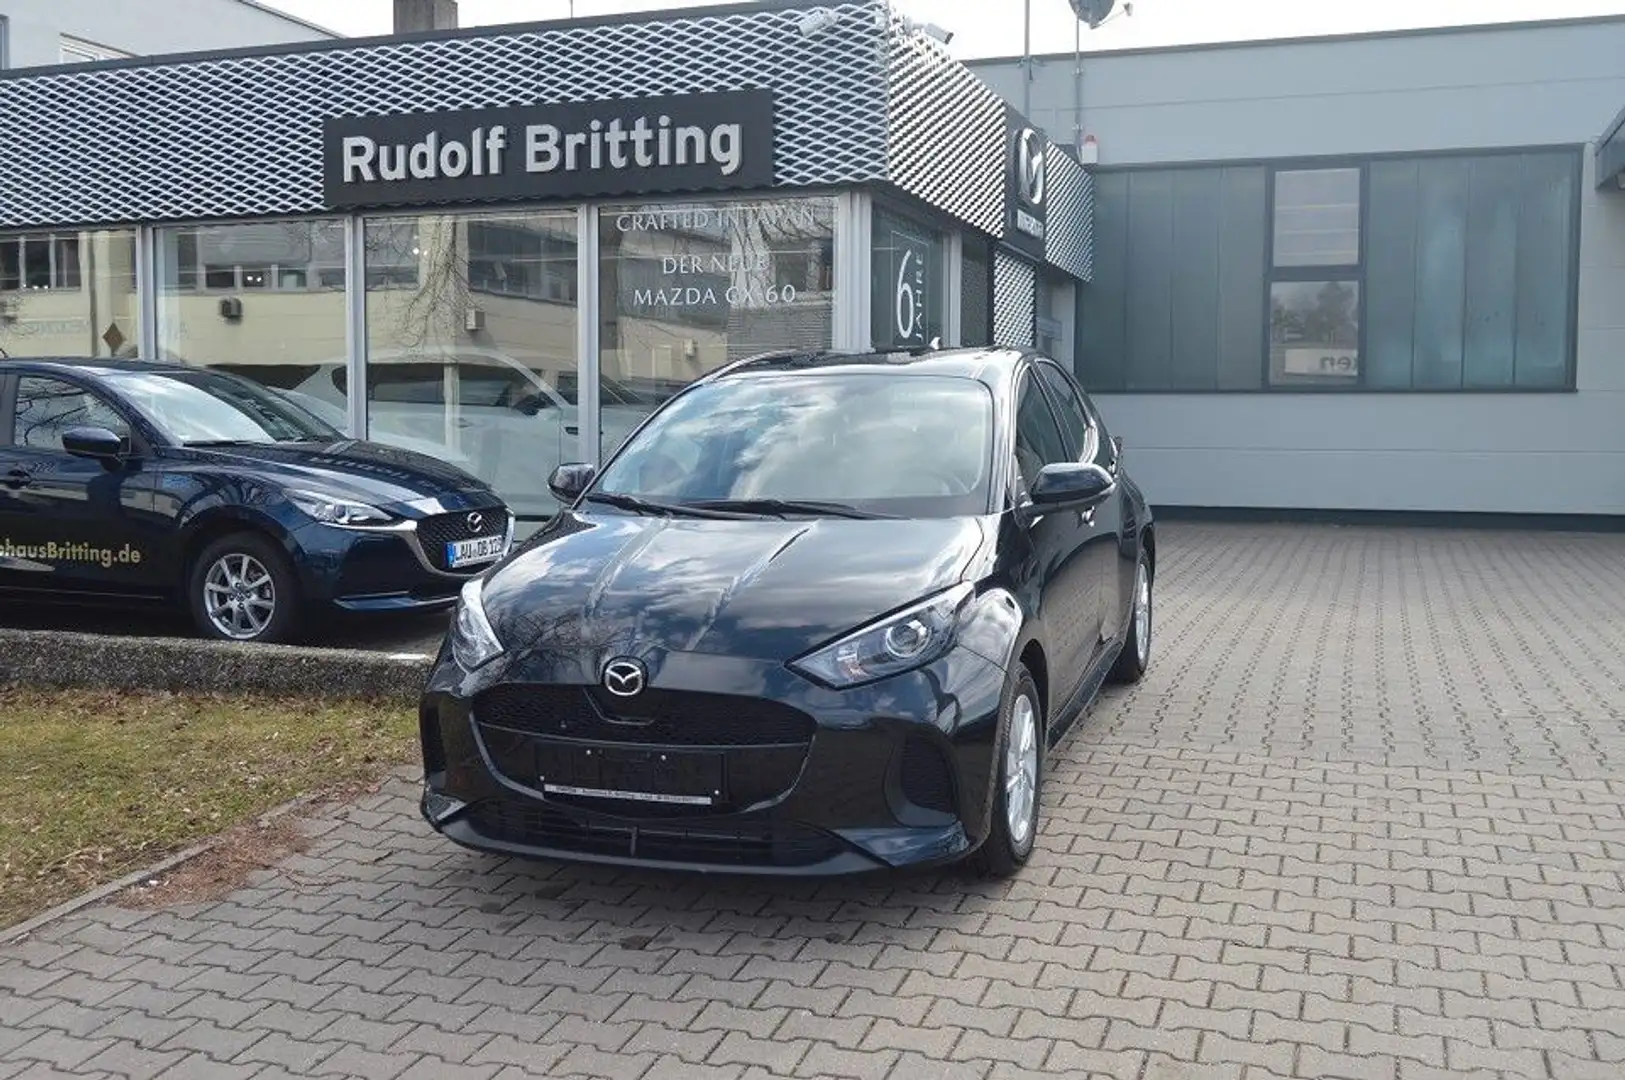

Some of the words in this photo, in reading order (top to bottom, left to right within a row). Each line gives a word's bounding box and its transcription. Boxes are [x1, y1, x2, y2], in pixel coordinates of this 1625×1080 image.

[342, 126, 506, 183] Rudolf
[526, 115, 742, 176] Britting
[616, 213, 709, 231] CRAFTED
[718, 208, 740, 228] IN
[663, 257, 703, 274] DER
[711, 254, 769, 273] NEUE
[633, 288, 717, 306] MAZDA
[897, 249, 914, 338] 6
[916, 253, 924, 342] JAHRE
